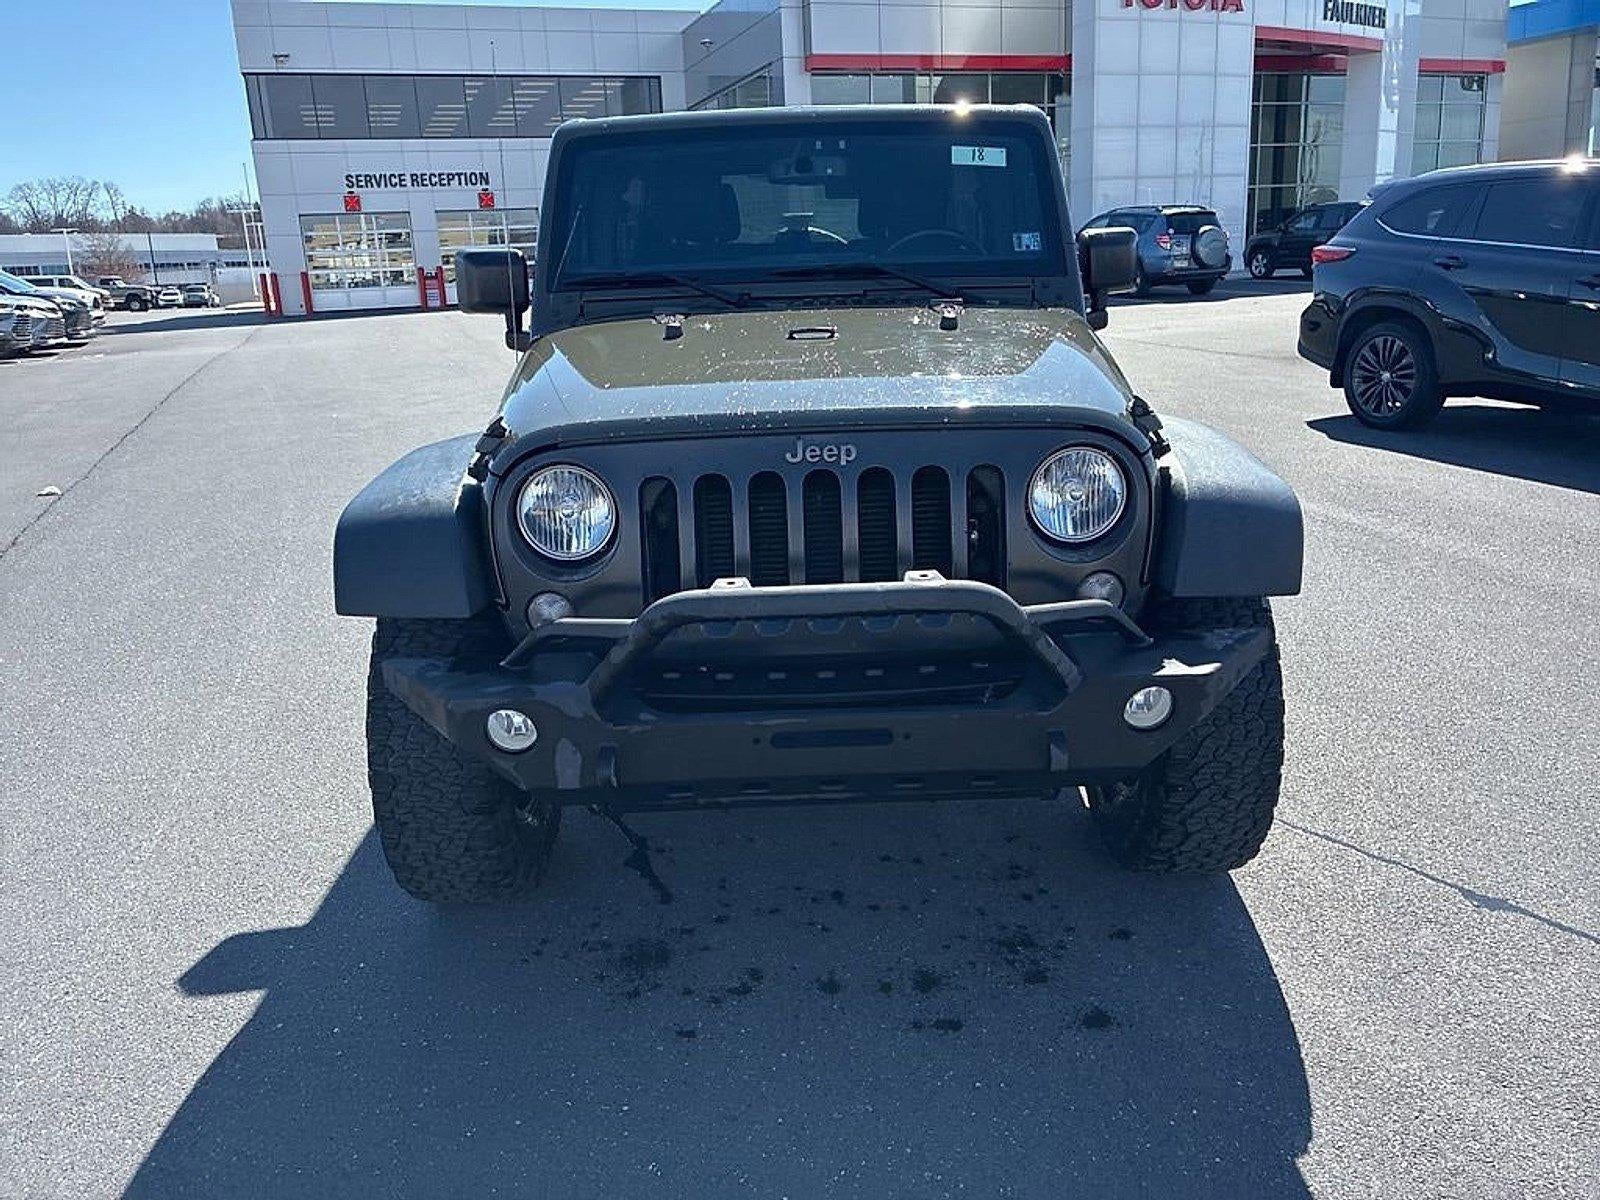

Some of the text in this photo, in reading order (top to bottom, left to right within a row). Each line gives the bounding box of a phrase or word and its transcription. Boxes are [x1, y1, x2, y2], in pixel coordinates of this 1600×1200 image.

[1323, 0, 1386, 28] FAULKNER
[345, 171, 490, 188] SERVICE RECEPTION
[786, 440, 857, 465] Jeep
